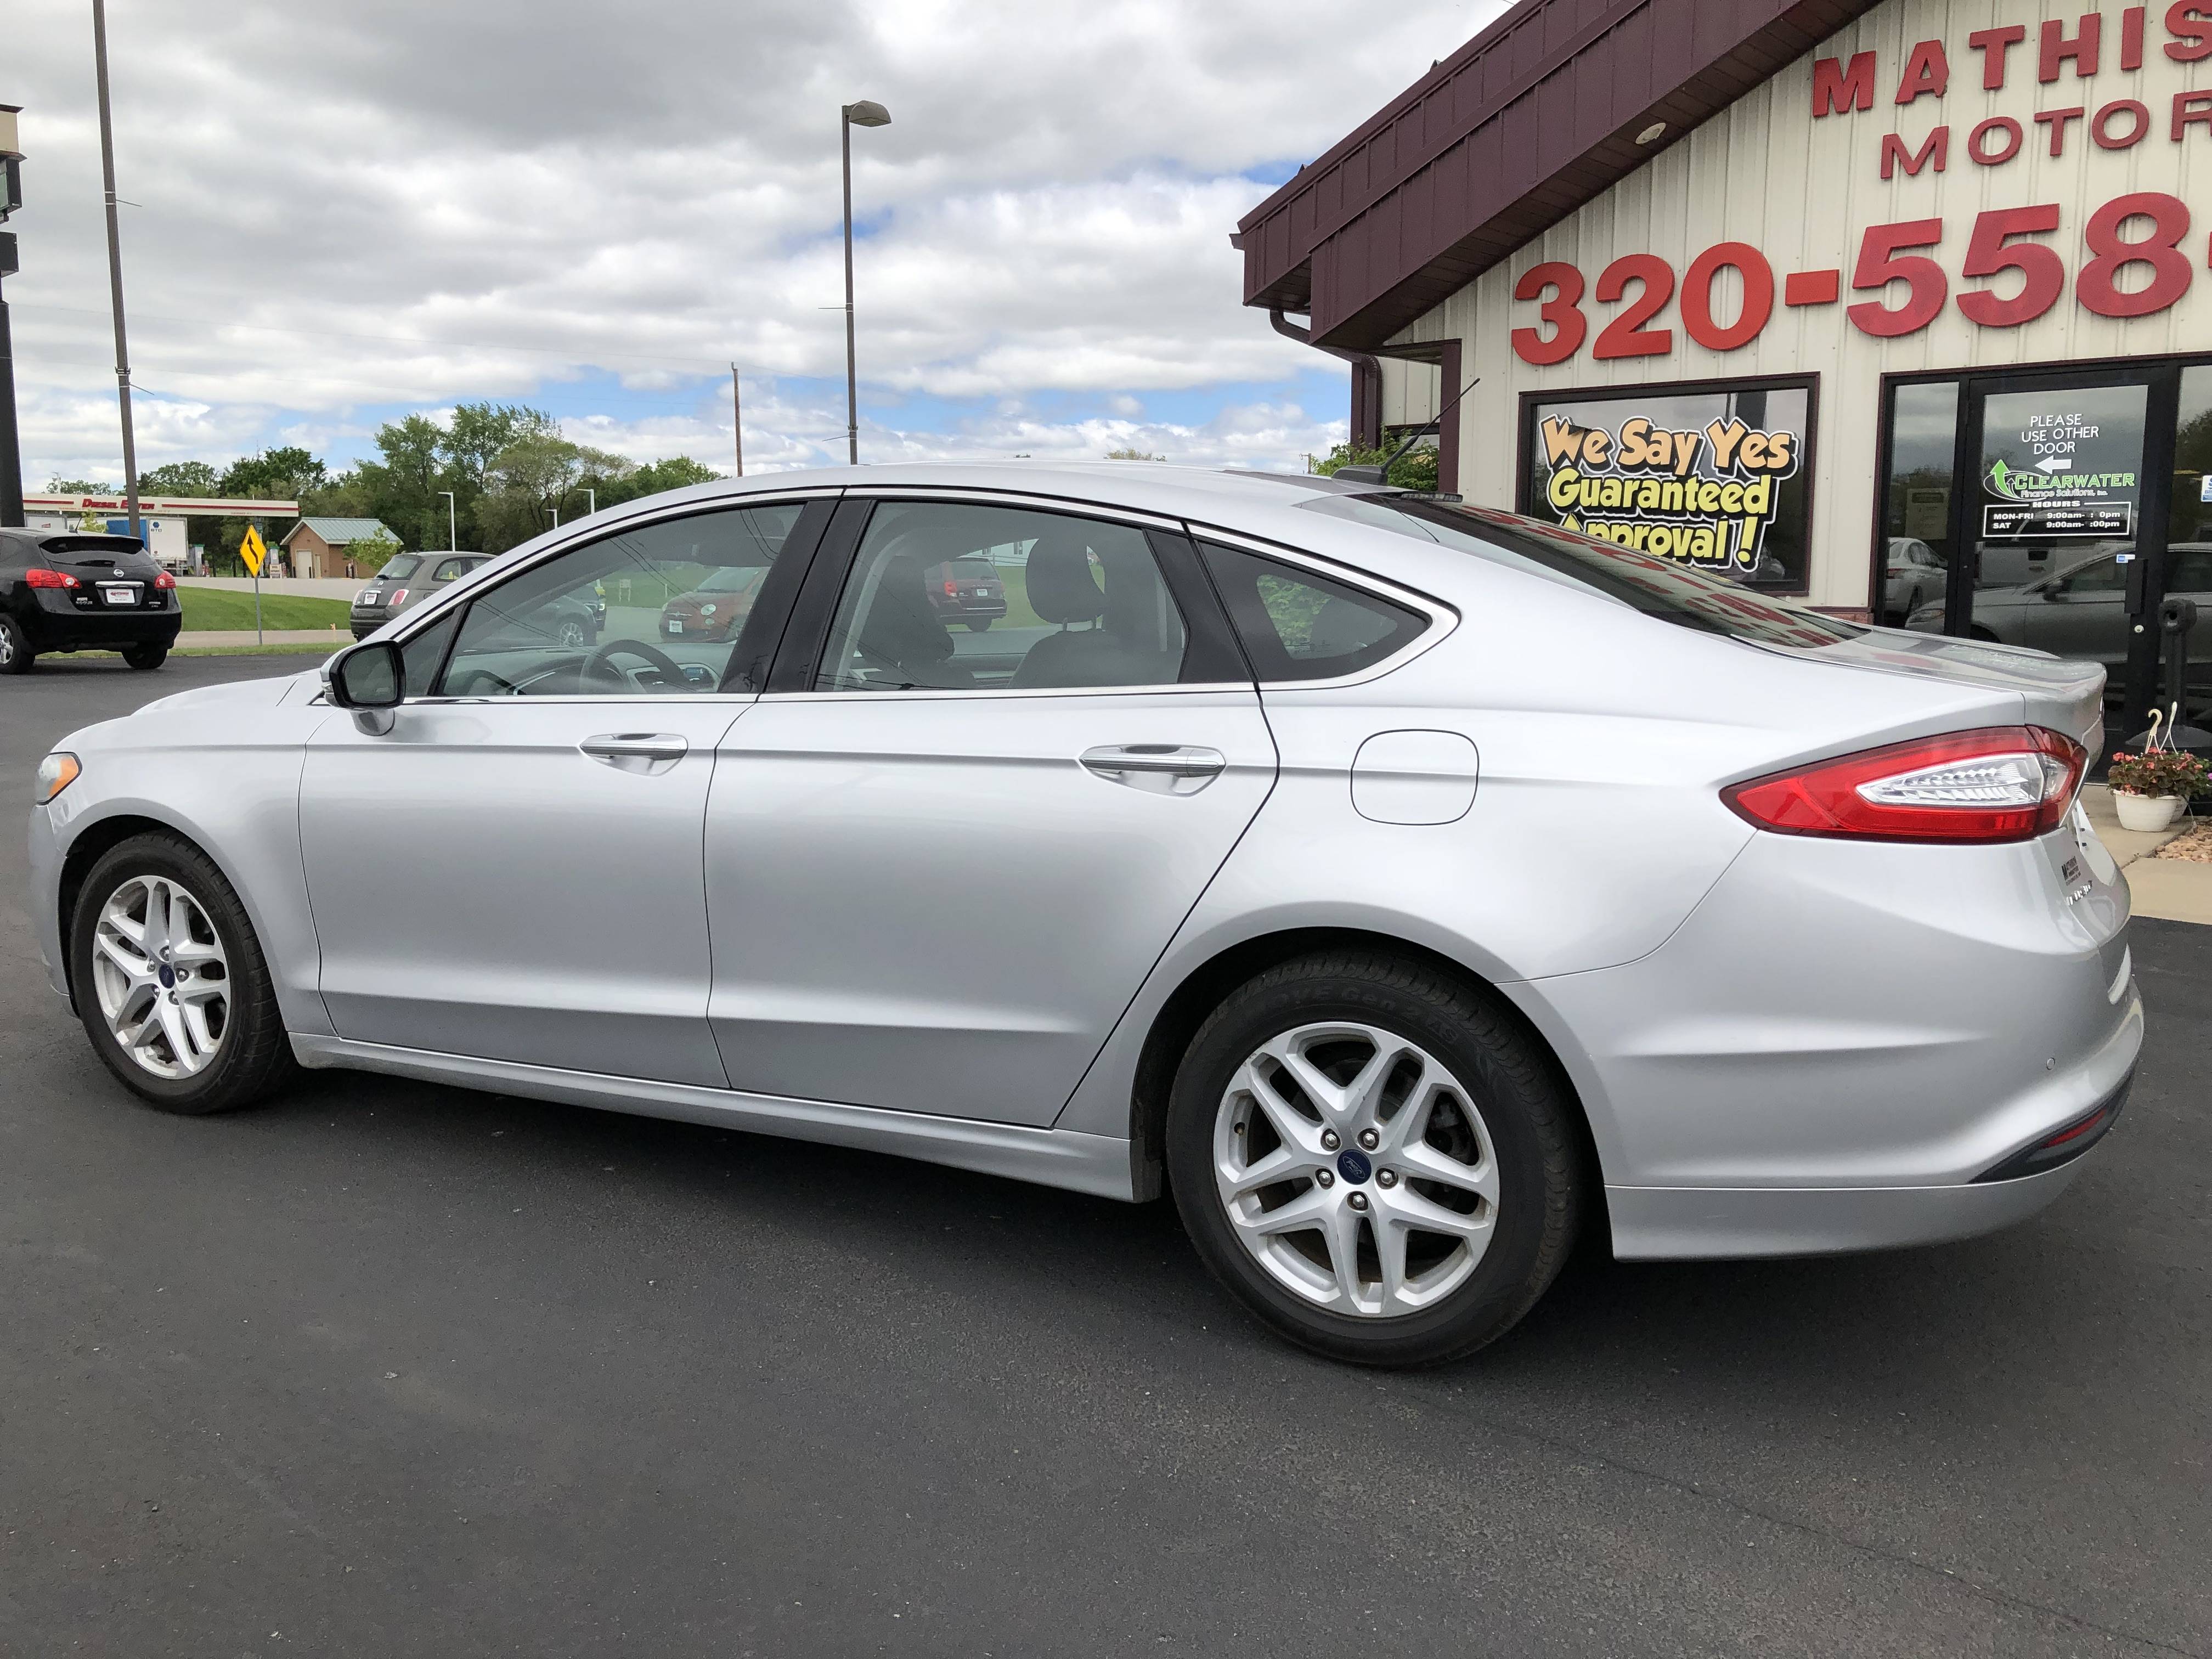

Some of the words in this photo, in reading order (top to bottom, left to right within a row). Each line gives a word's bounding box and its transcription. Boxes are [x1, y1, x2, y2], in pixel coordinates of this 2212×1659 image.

[1511, 192, 2212, 365] 320-558
[2030, 414, 2082, 427] PLEASE
[2021, 430, 2047, 443] USE
[2053, 426, 2099, 439] OTHER
[1541, 416, 1609, 466] We
[1618, 417, 1700, 476] Say
[1707, 419, 1791, 469] Yes
[2033, 442, 2075, 455] DOOR
[2015, 473, 2135, 490] CLEARWATER
[1550, 467, 1771, 514] Guaranteed
